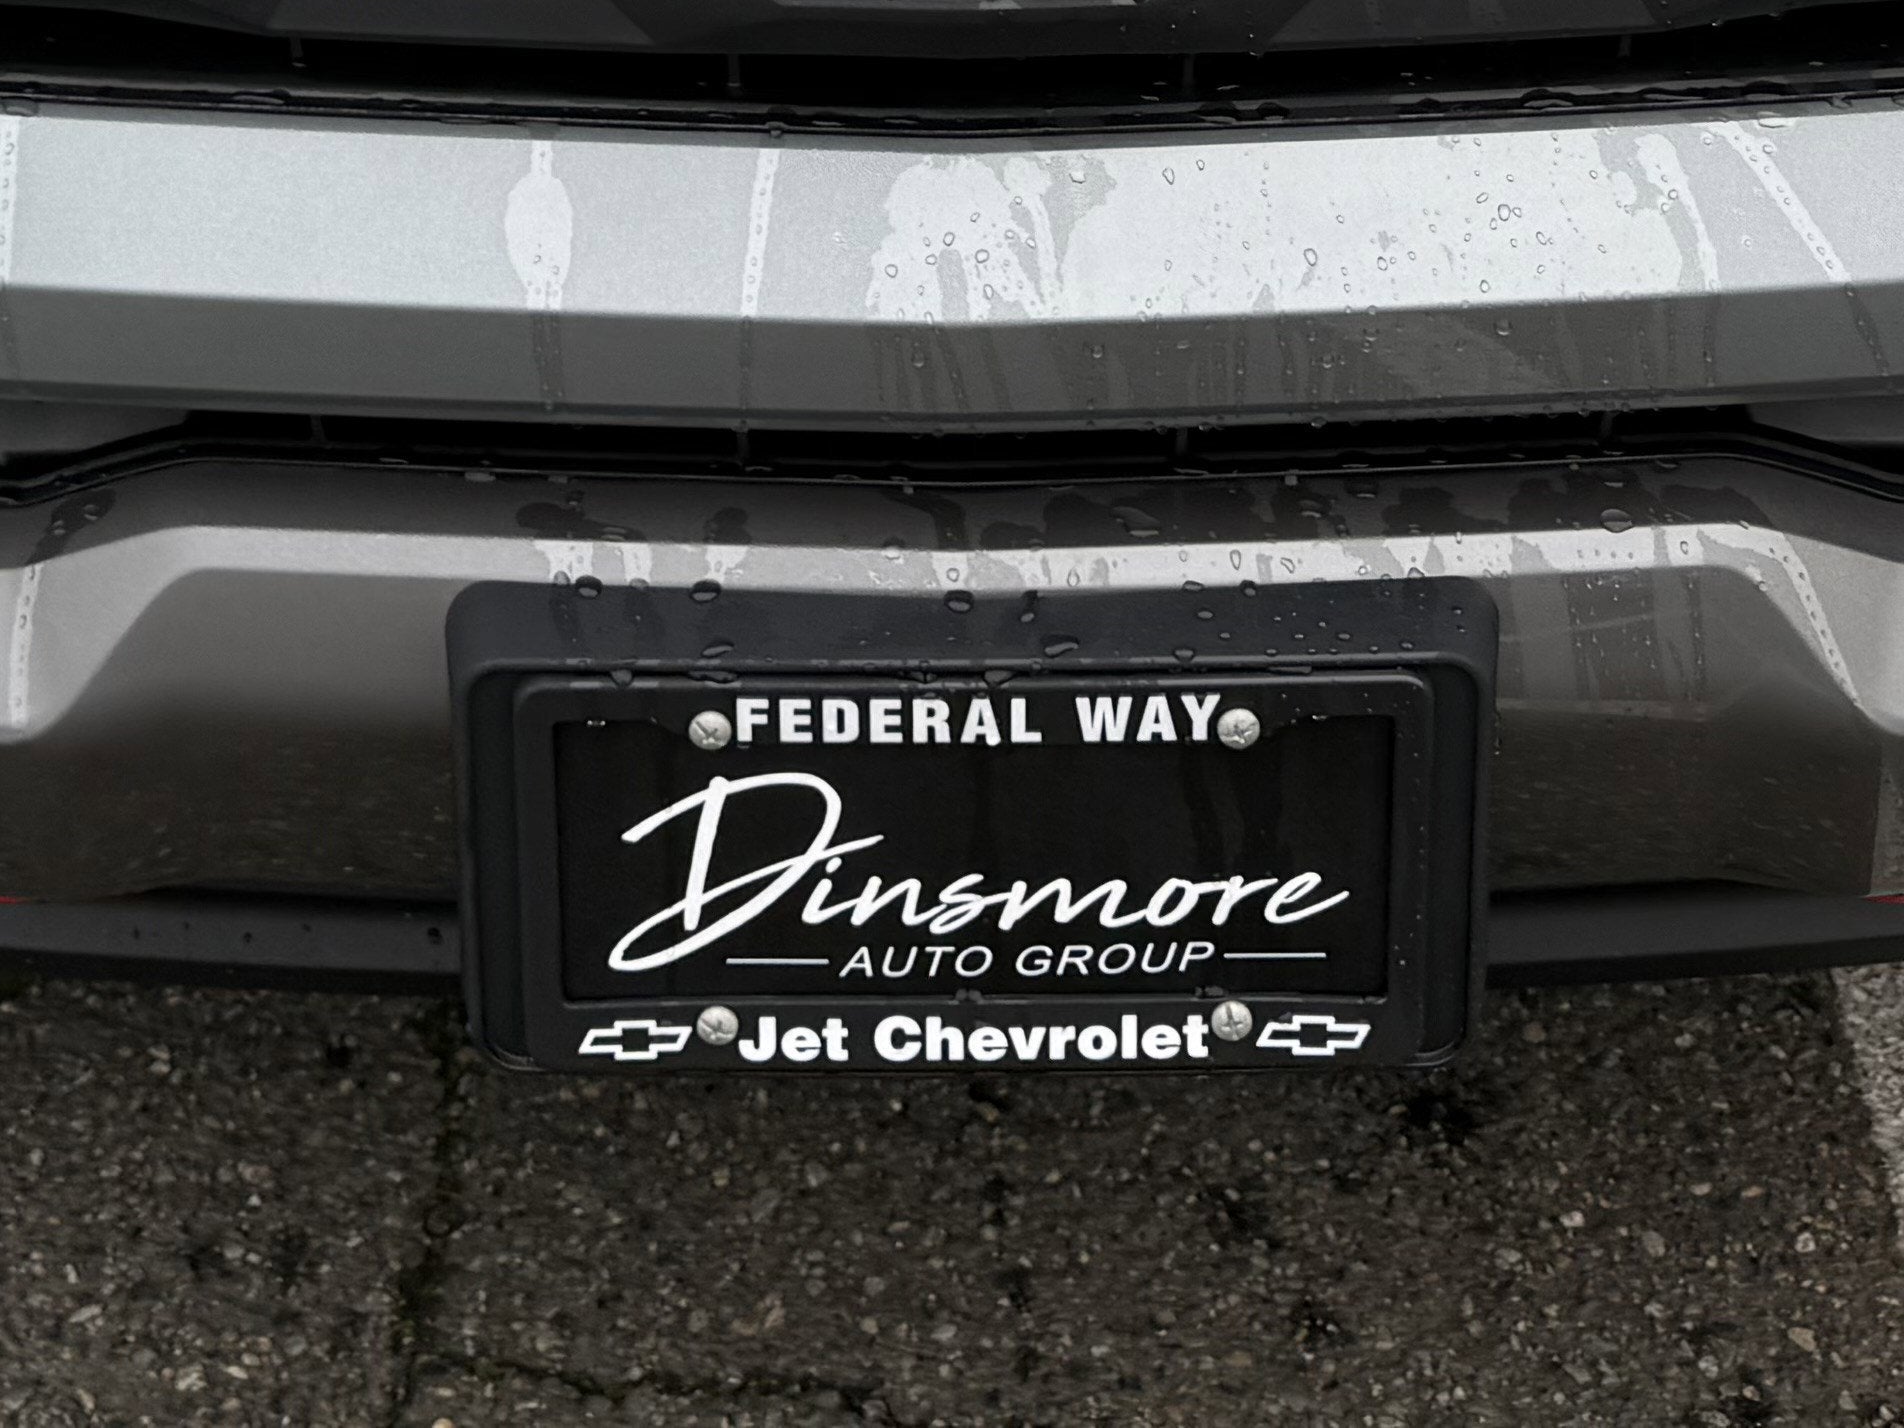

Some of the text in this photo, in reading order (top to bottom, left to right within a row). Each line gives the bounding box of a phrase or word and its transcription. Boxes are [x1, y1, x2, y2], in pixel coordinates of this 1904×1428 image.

[735, 693, 1222, 746] FEDERAL WAY
[606, 771, 1350, 973] Dinsmore
[837, 941, 1216, 978] AUTO GROUP
[737, 1013, 1210, 1063] Jet Chevrolet
